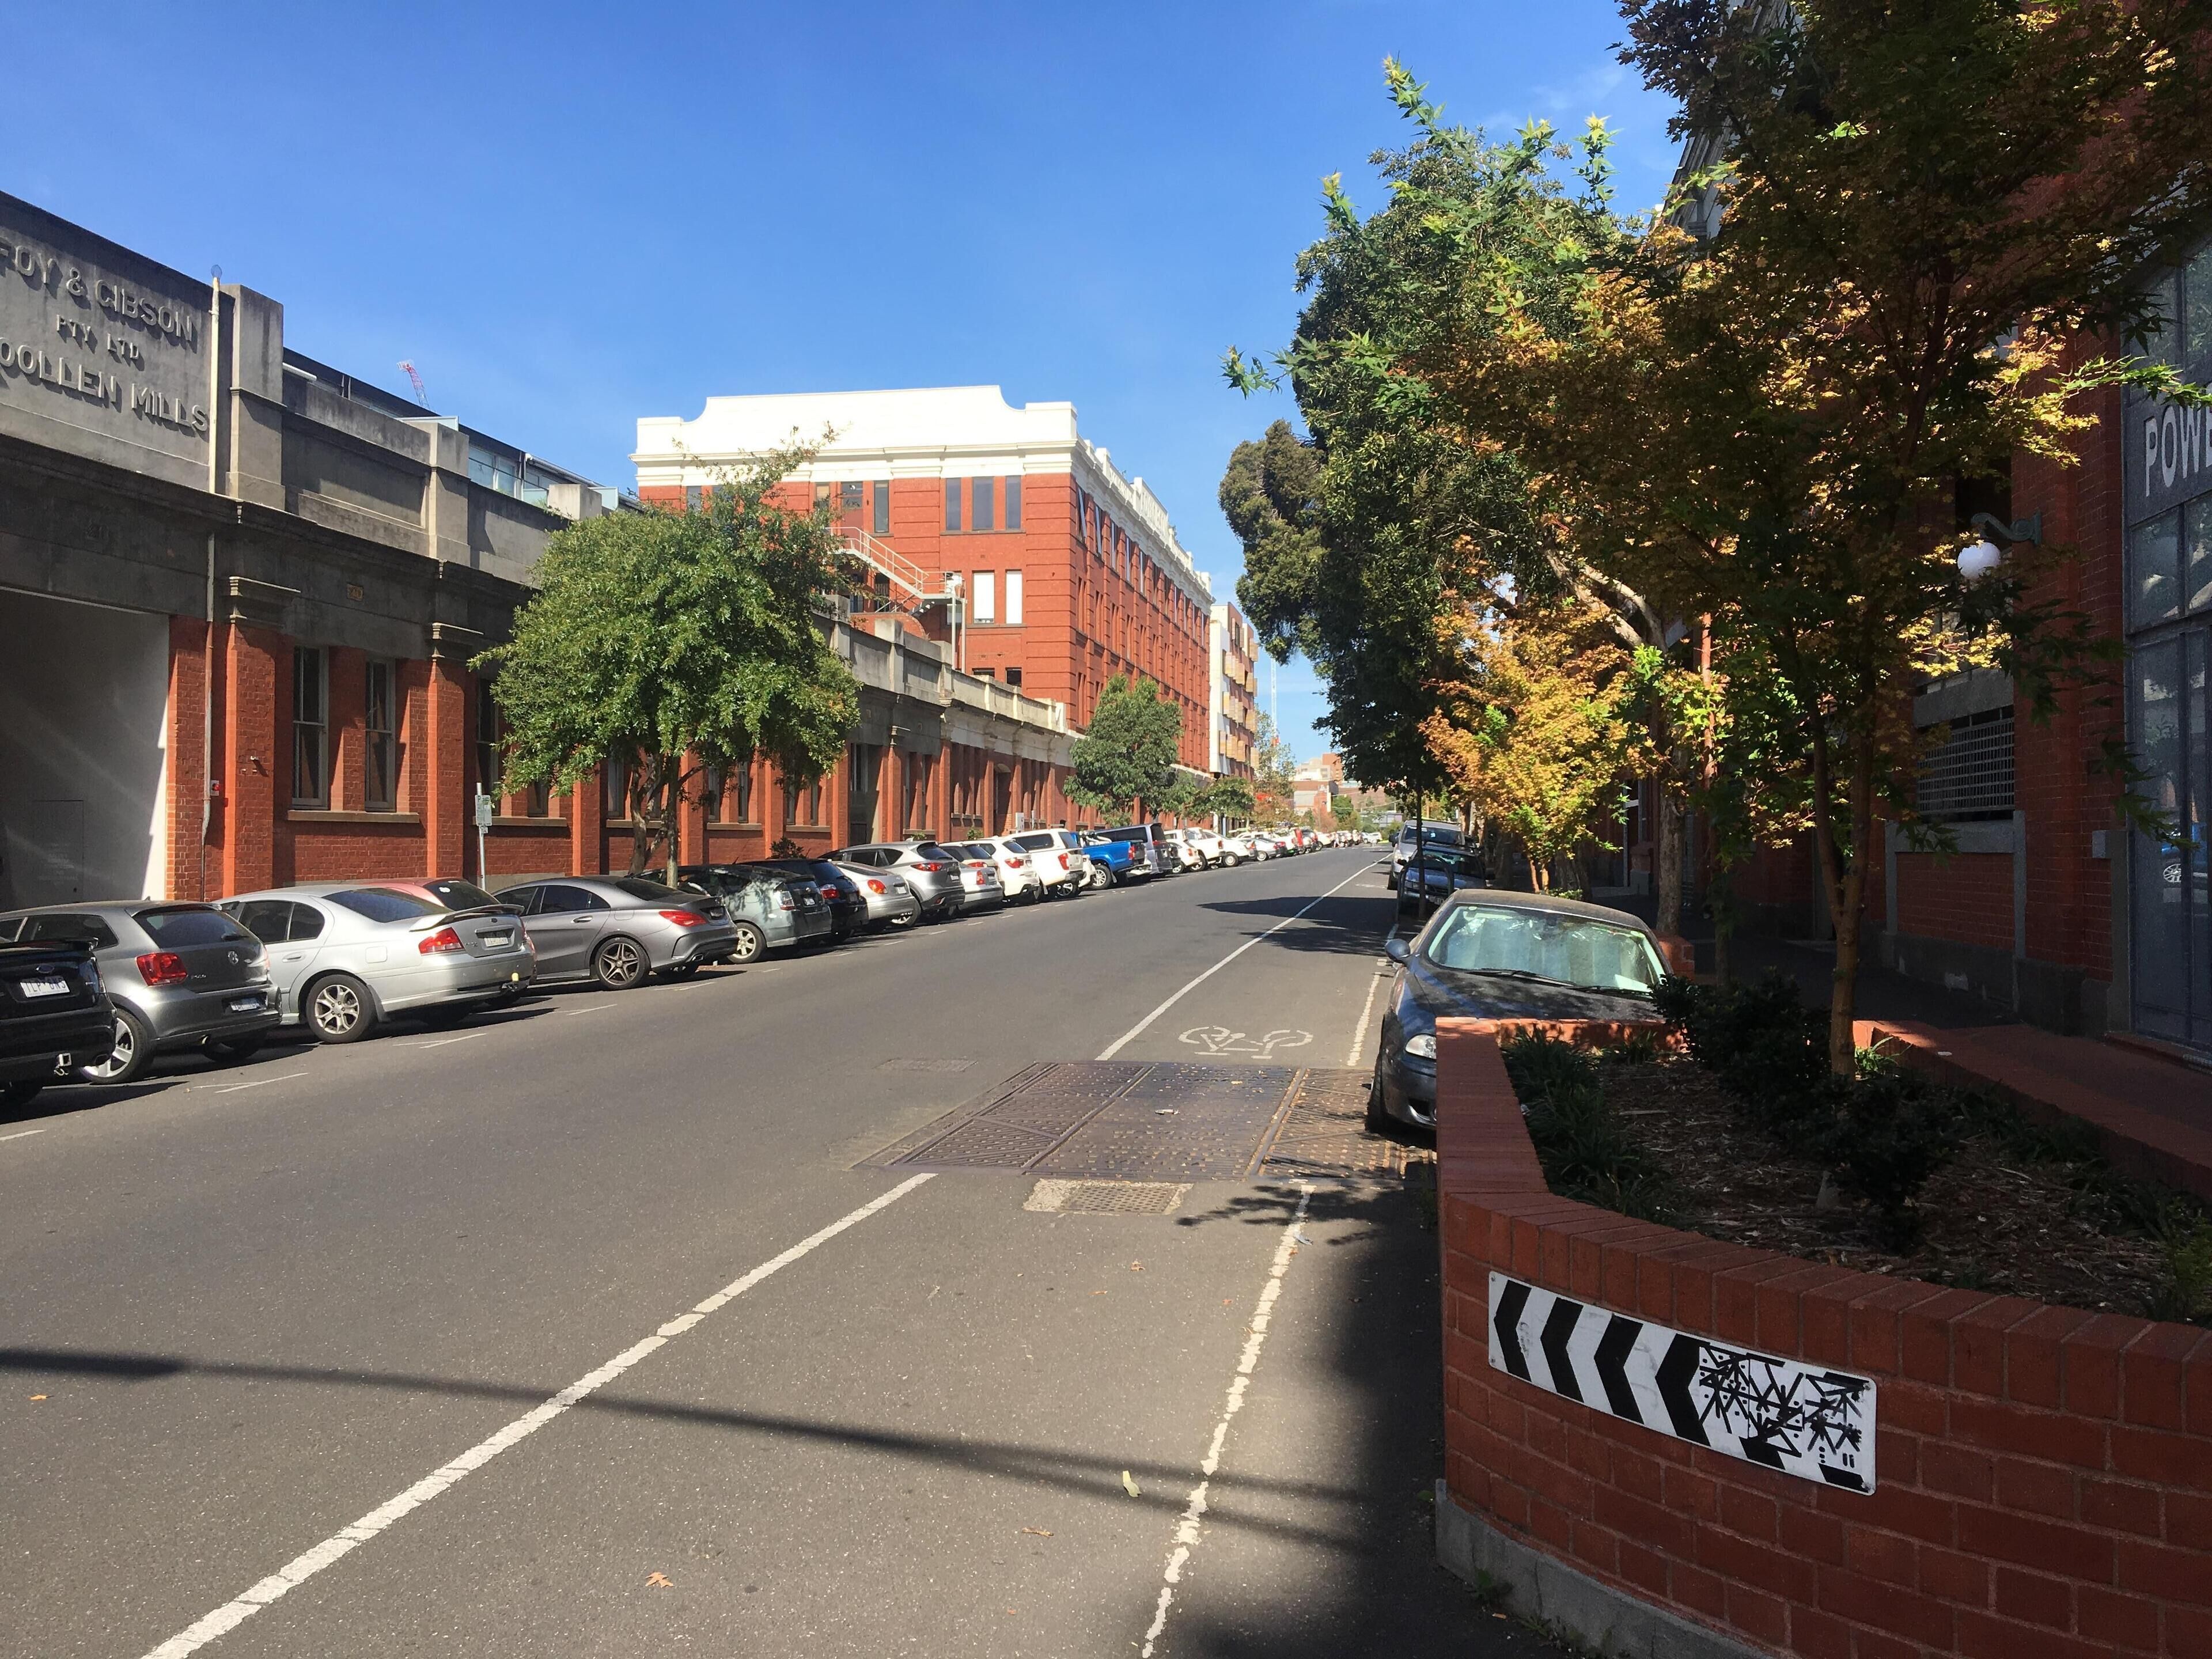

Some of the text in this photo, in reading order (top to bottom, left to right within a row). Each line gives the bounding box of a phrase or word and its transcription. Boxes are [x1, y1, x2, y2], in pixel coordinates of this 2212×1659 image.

[66, 267, 85, 296] &
[96, 279, 192, 341] GIBSON
[56, 315, 139, 359] PTY LTD
[131, 383, 208, 431] MILLS
